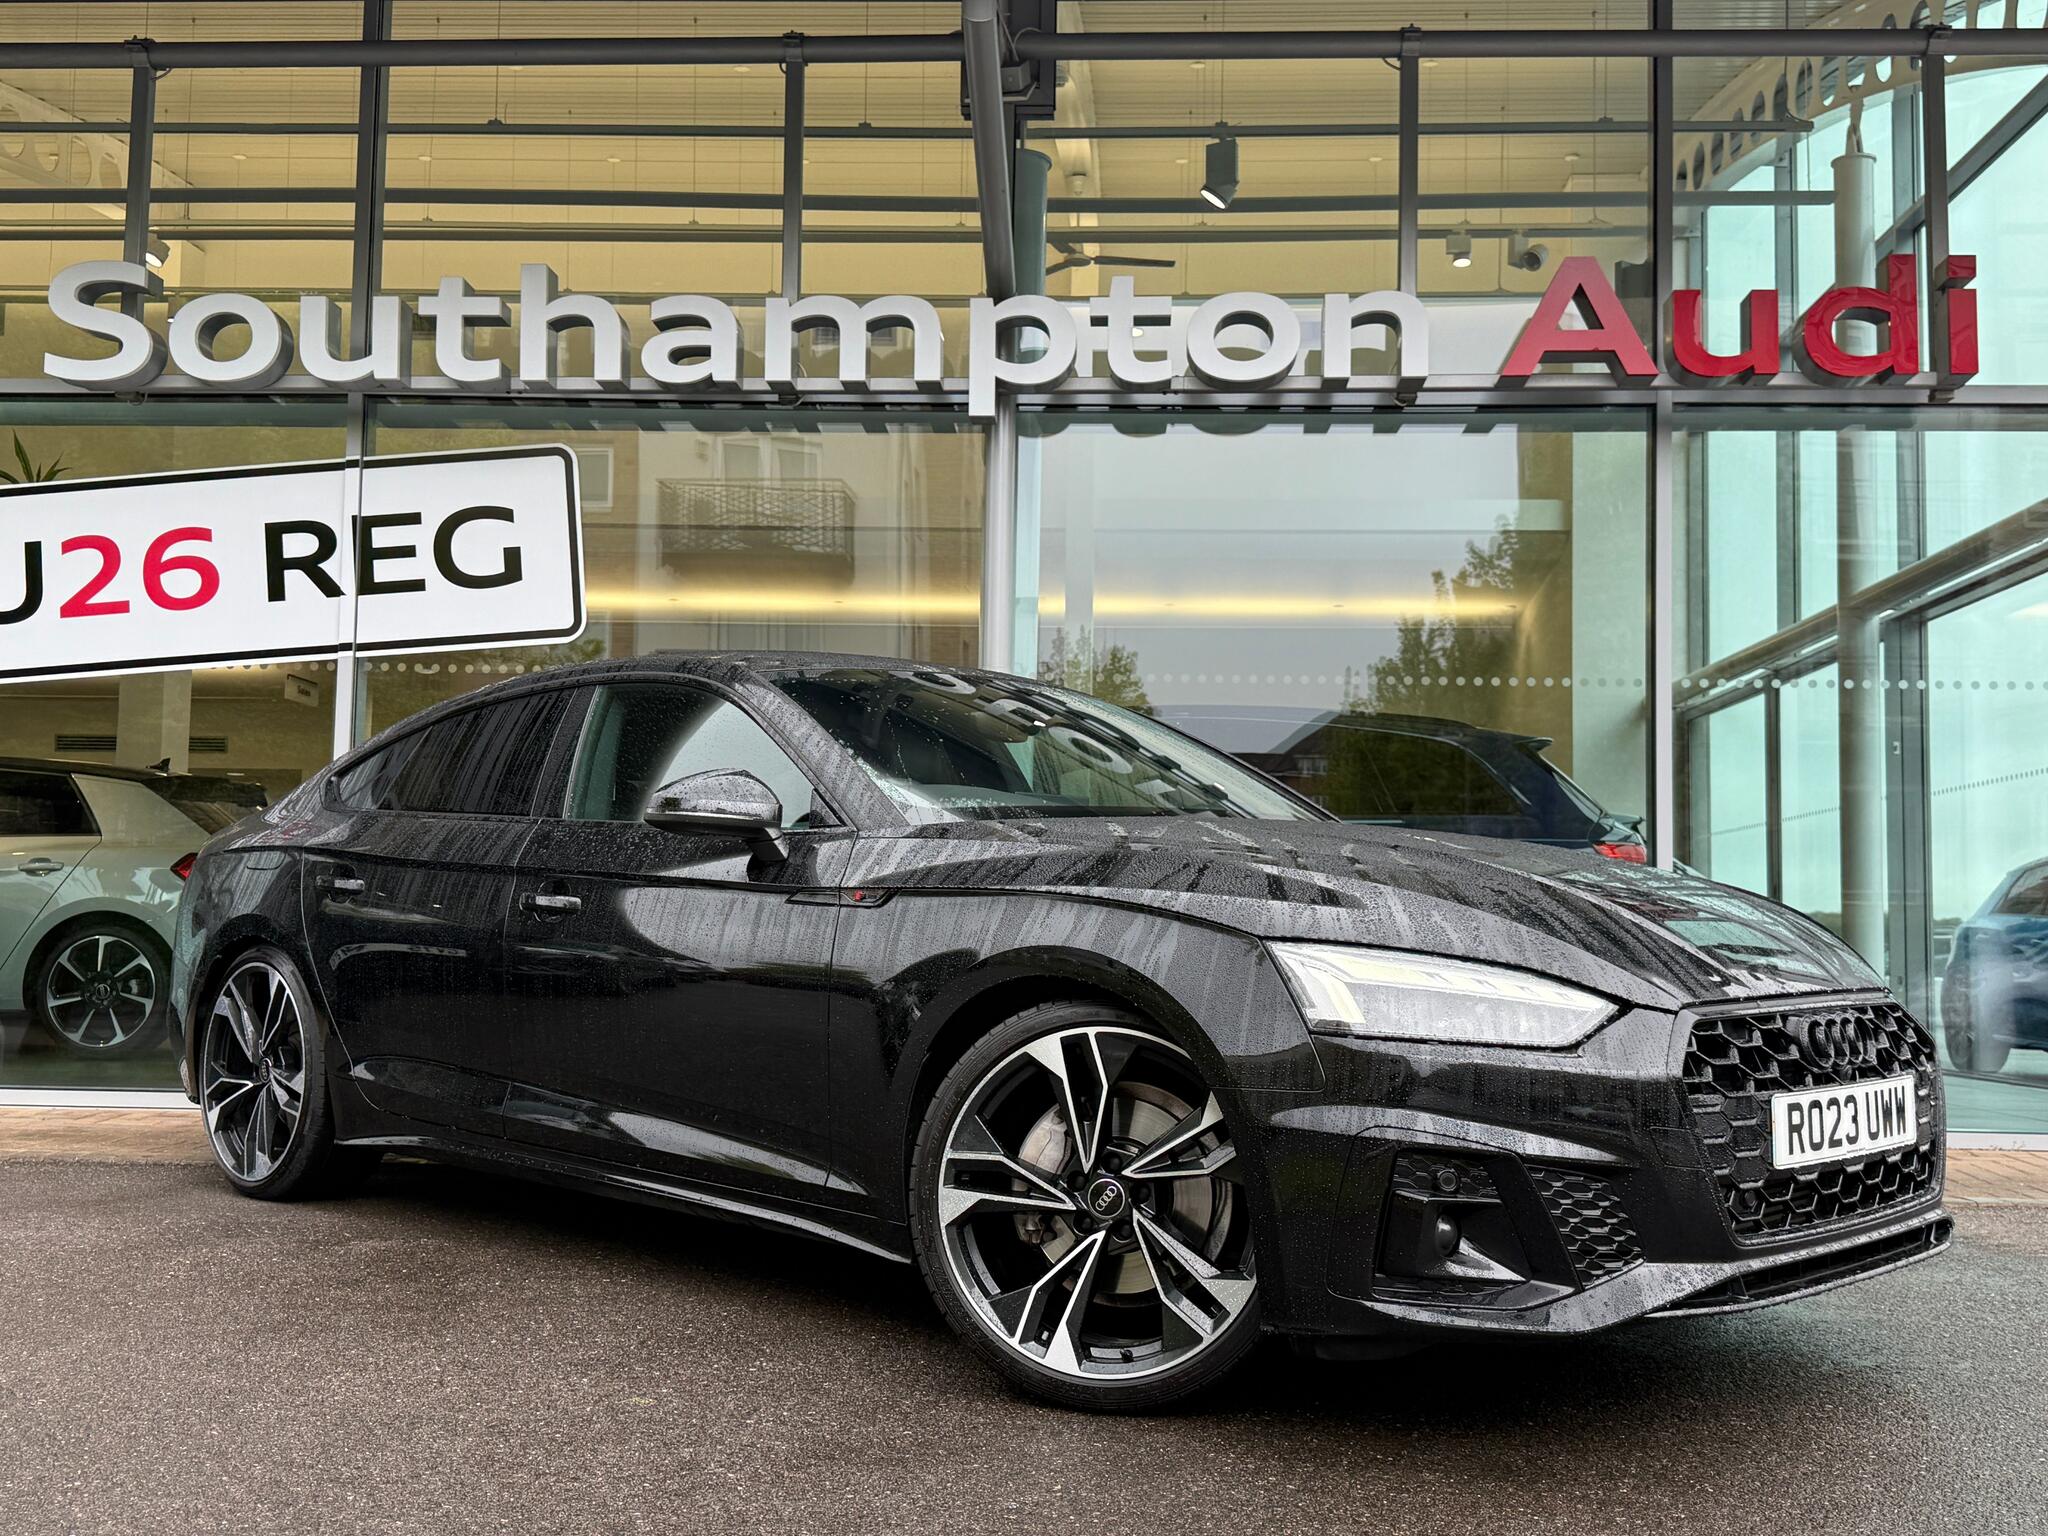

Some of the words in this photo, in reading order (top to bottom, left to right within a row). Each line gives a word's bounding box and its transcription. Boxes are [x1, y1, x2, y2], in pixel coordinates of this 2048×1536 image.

[43, 260, 1429, 420] Southampton
[1498, 254, 1980, 382] Audi
[263, 505, 524, 604] REG
[1786, 1094, 1860, 1156] RO23
[1864, 1085, 1907, 1142] UWW
